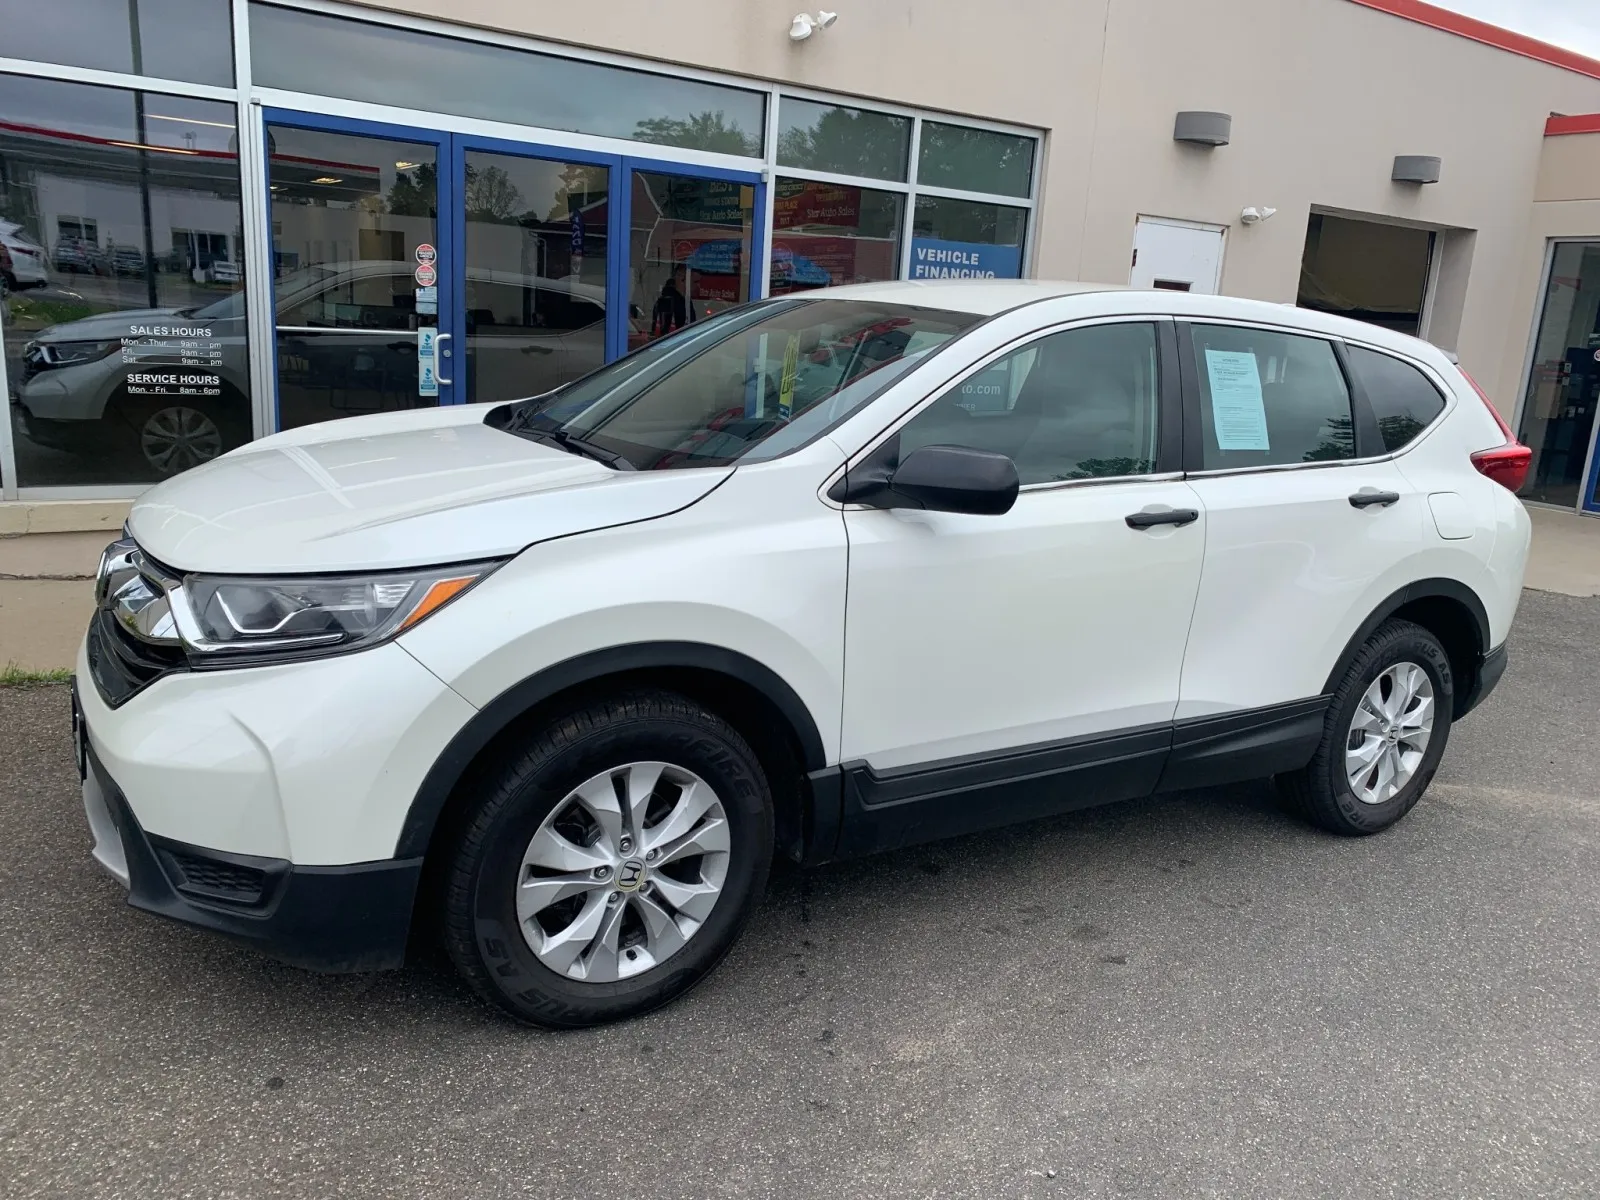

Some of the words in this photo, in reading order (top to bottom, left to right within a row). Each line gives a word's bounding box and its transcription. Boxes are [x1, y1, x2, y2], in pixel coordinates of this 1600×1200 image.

[820, 208, 836, 217] Auto
[838, 206, 854, 216] Sales
[917, 248, 980, 265] VEHICLE
[916, 264, 995, 280] FINANCING
[130, 326, 168, 335] SALES
[172, 327, 212, 337] HOURS
[120, 338, 140, 346] Mon.
[148, 339, 168, 347] Thur.
[127, 374, 177, 383] SERVICE
[180, 376, 220, 384] HOURS
